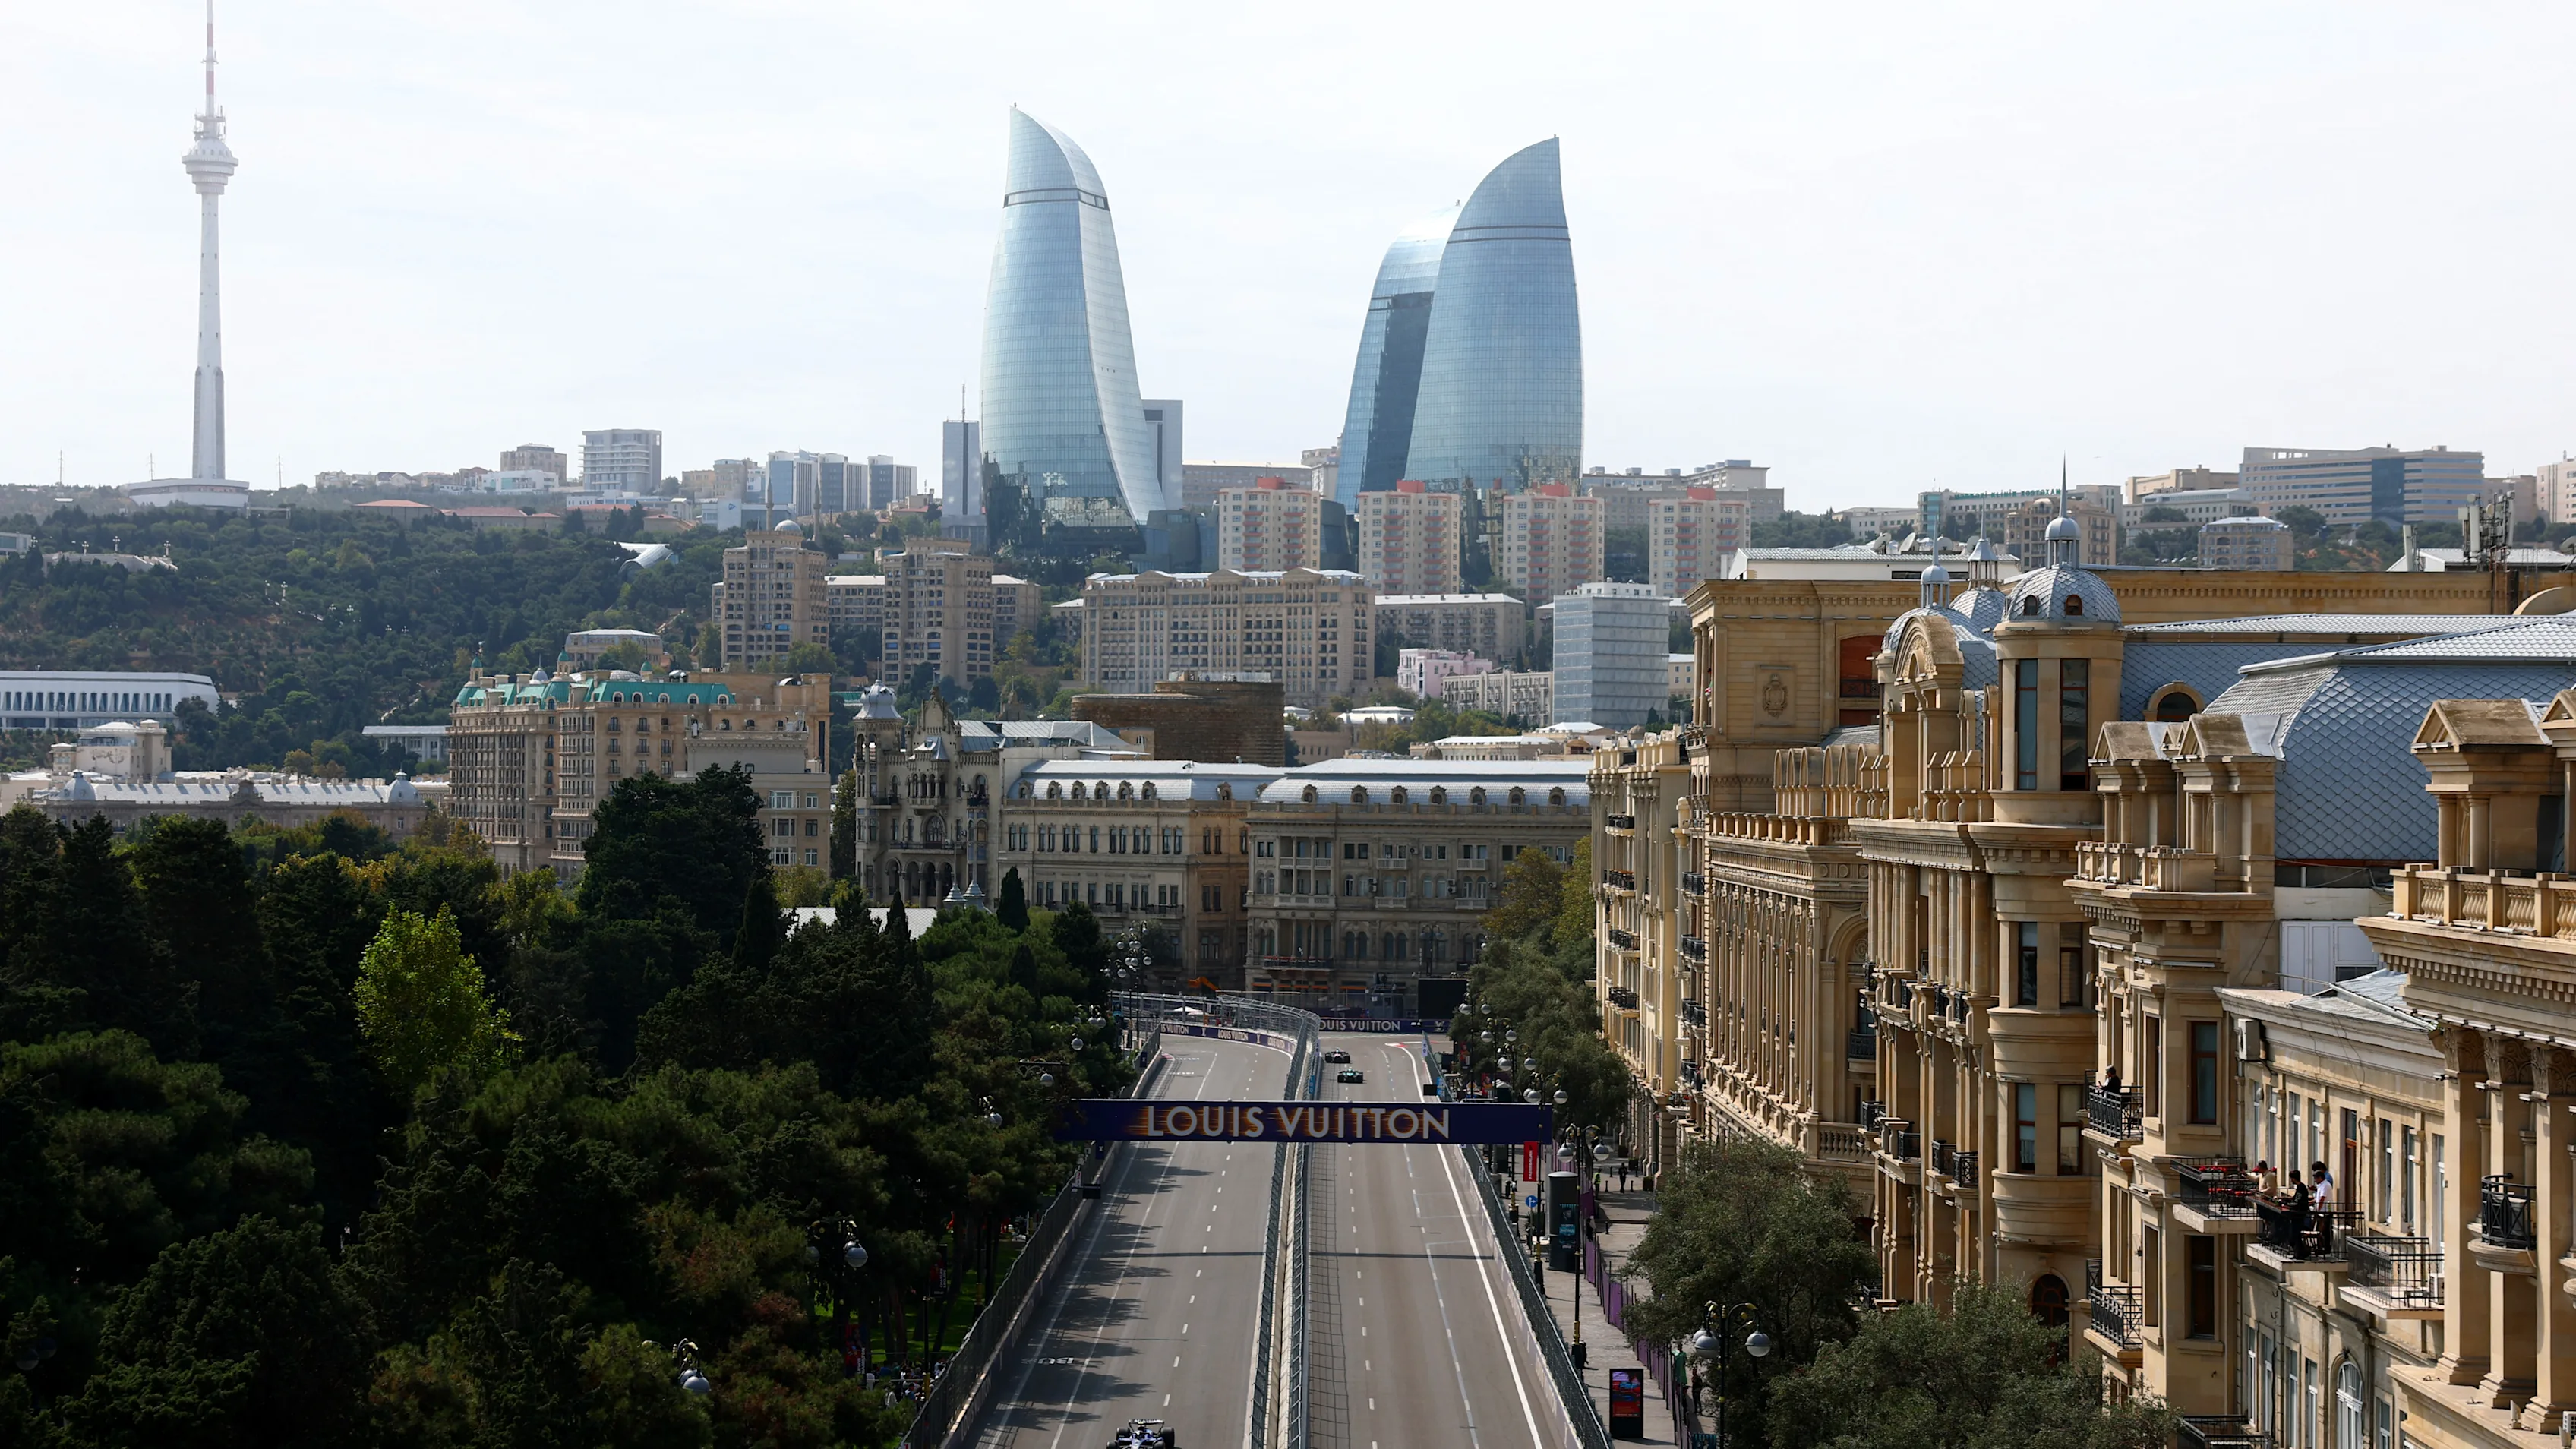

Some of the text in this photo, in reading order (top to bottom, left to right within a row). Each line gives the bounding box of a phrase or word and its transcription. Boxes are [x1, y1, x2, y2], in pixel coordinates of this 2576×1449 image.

[1166, 1024, 1189, 1034] VUITTON
[1320, 1020, 1400, 1031] OUIS VUITTON
[1217, 1029, 1230, 1039] LOUIS
[1148, 1106, 1449, 1139] LOUIS VUITTON
